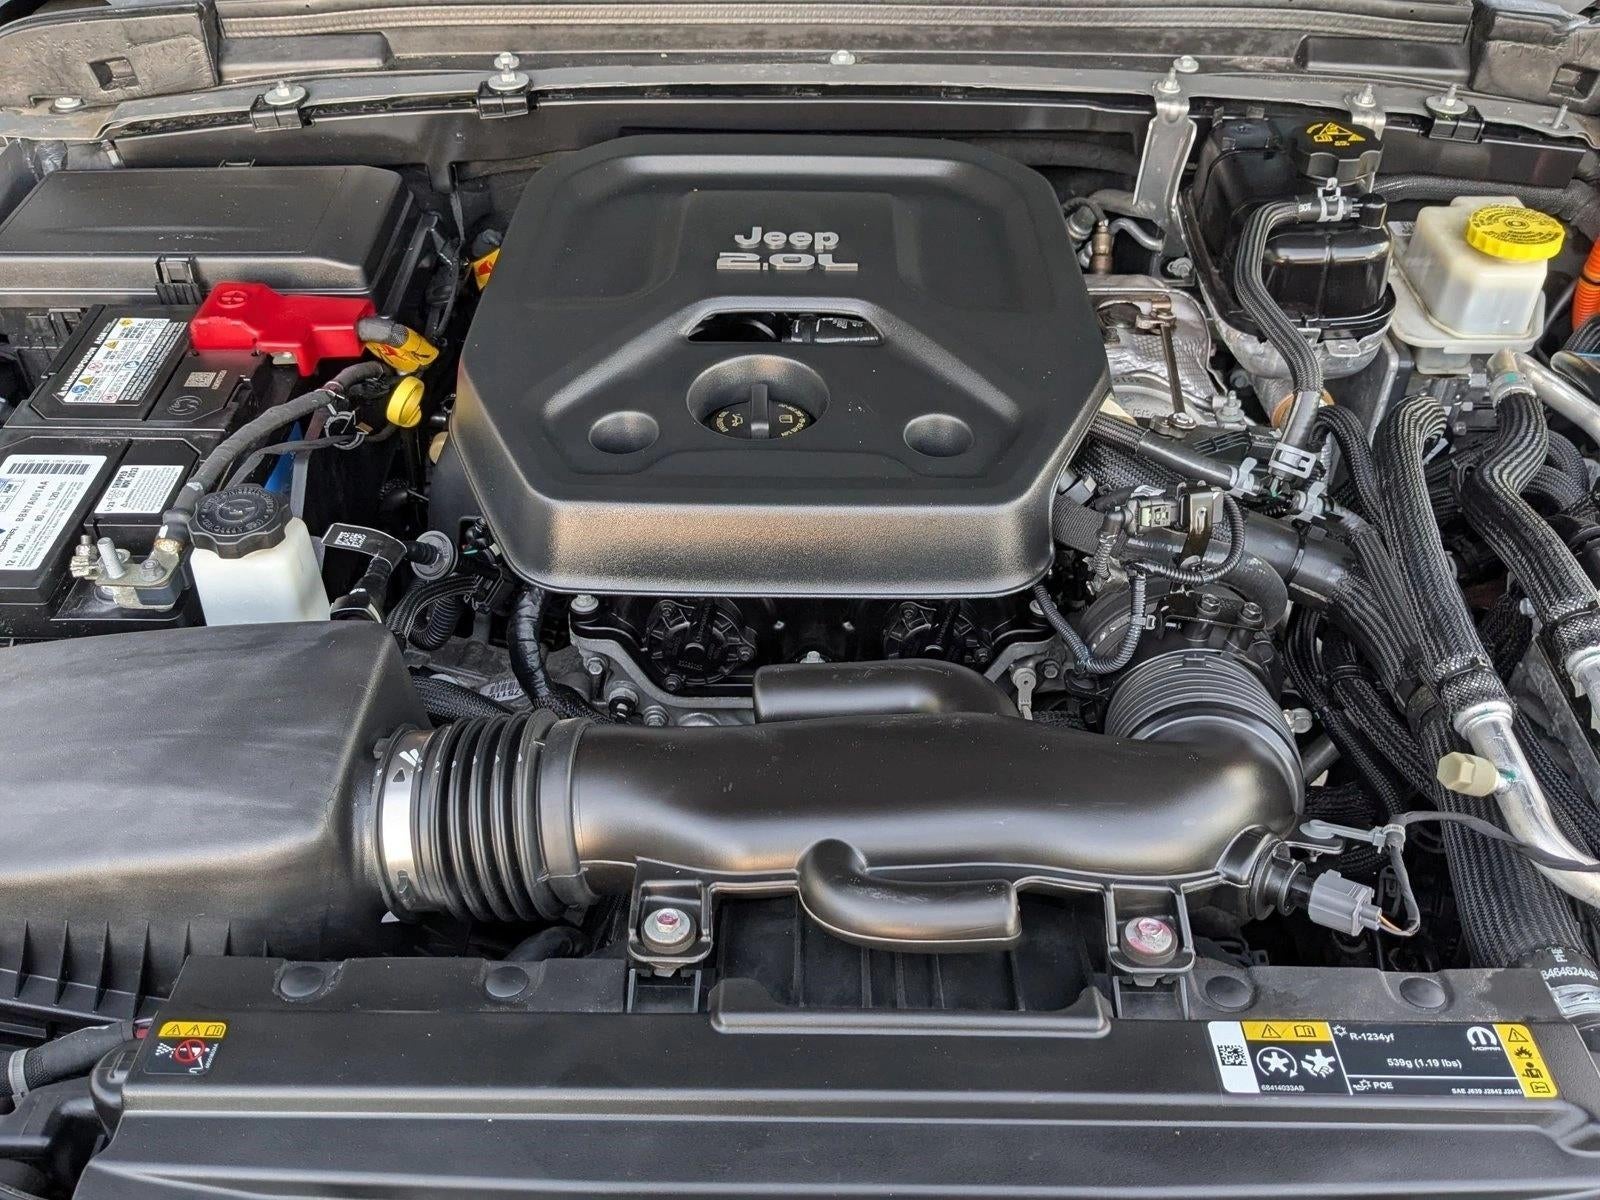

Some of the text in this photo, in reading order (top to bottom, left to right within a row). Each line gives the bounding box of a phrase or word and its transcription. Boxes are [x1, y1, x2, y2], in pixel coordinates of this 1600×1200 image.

[734, 226, 839, 253] Jeep
[716, 252, 859, 271] 2.0L
[1350, 1032, 1395, 1042] R-1234yf
[1387, 1058, 1463, 1070] 539g (1.19 lbs)
[1373, 1081, 1394, 1090] POE
